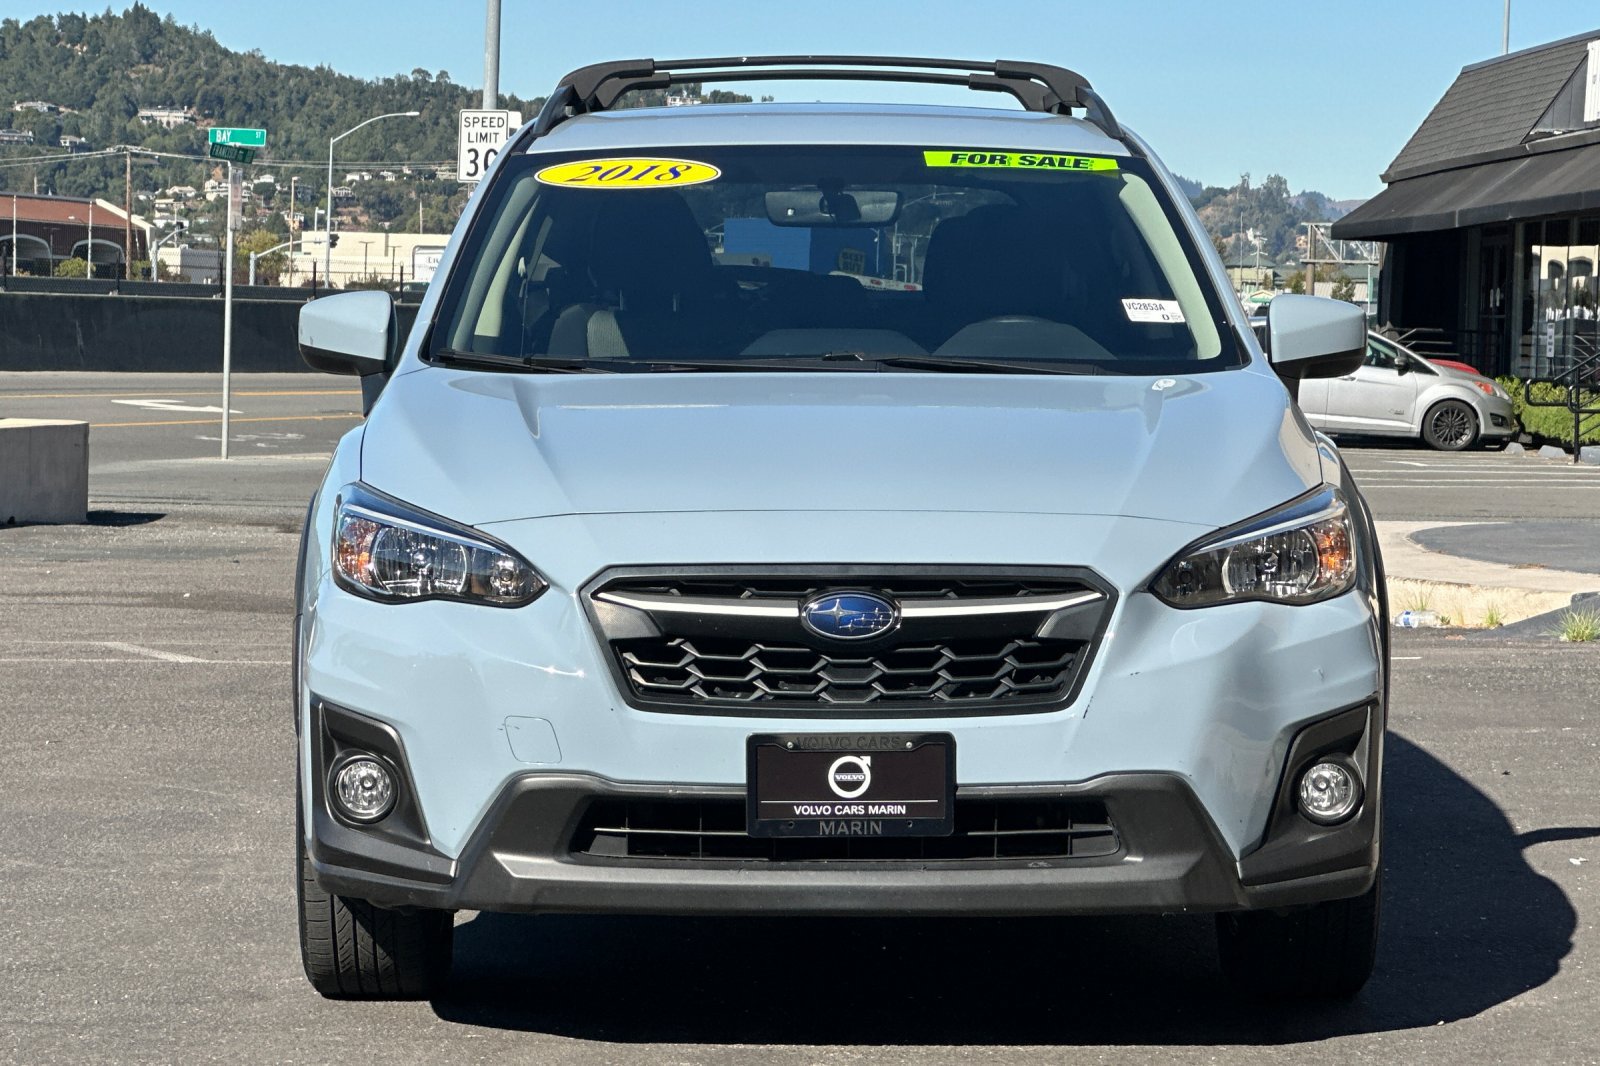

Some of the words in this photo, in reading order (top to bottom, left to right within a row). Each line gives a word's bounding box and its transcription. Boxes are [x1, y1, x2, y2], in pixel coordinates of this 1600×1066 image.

[464, 116, 505, 128] SPEED
[216, 130, 231, 143] BAY
[467, 131, 499, 143] LIMIT
[950, 153, 1010, 166] FOR
[1018, 154, 1092, 169] SALE
[565, 165, 692, 182] 2018
[1125, 303, 1165, 311] VC2853A
[796, 736, 851, 750] VOLVO
[856, 736, 901, 749] CARS
[793, 805, 831, 815] VOLVO
[834, 805, 865, 815] CARS
[868, 804, 906, 815] MARIN
[819, 821, 882, 835] MARIN
